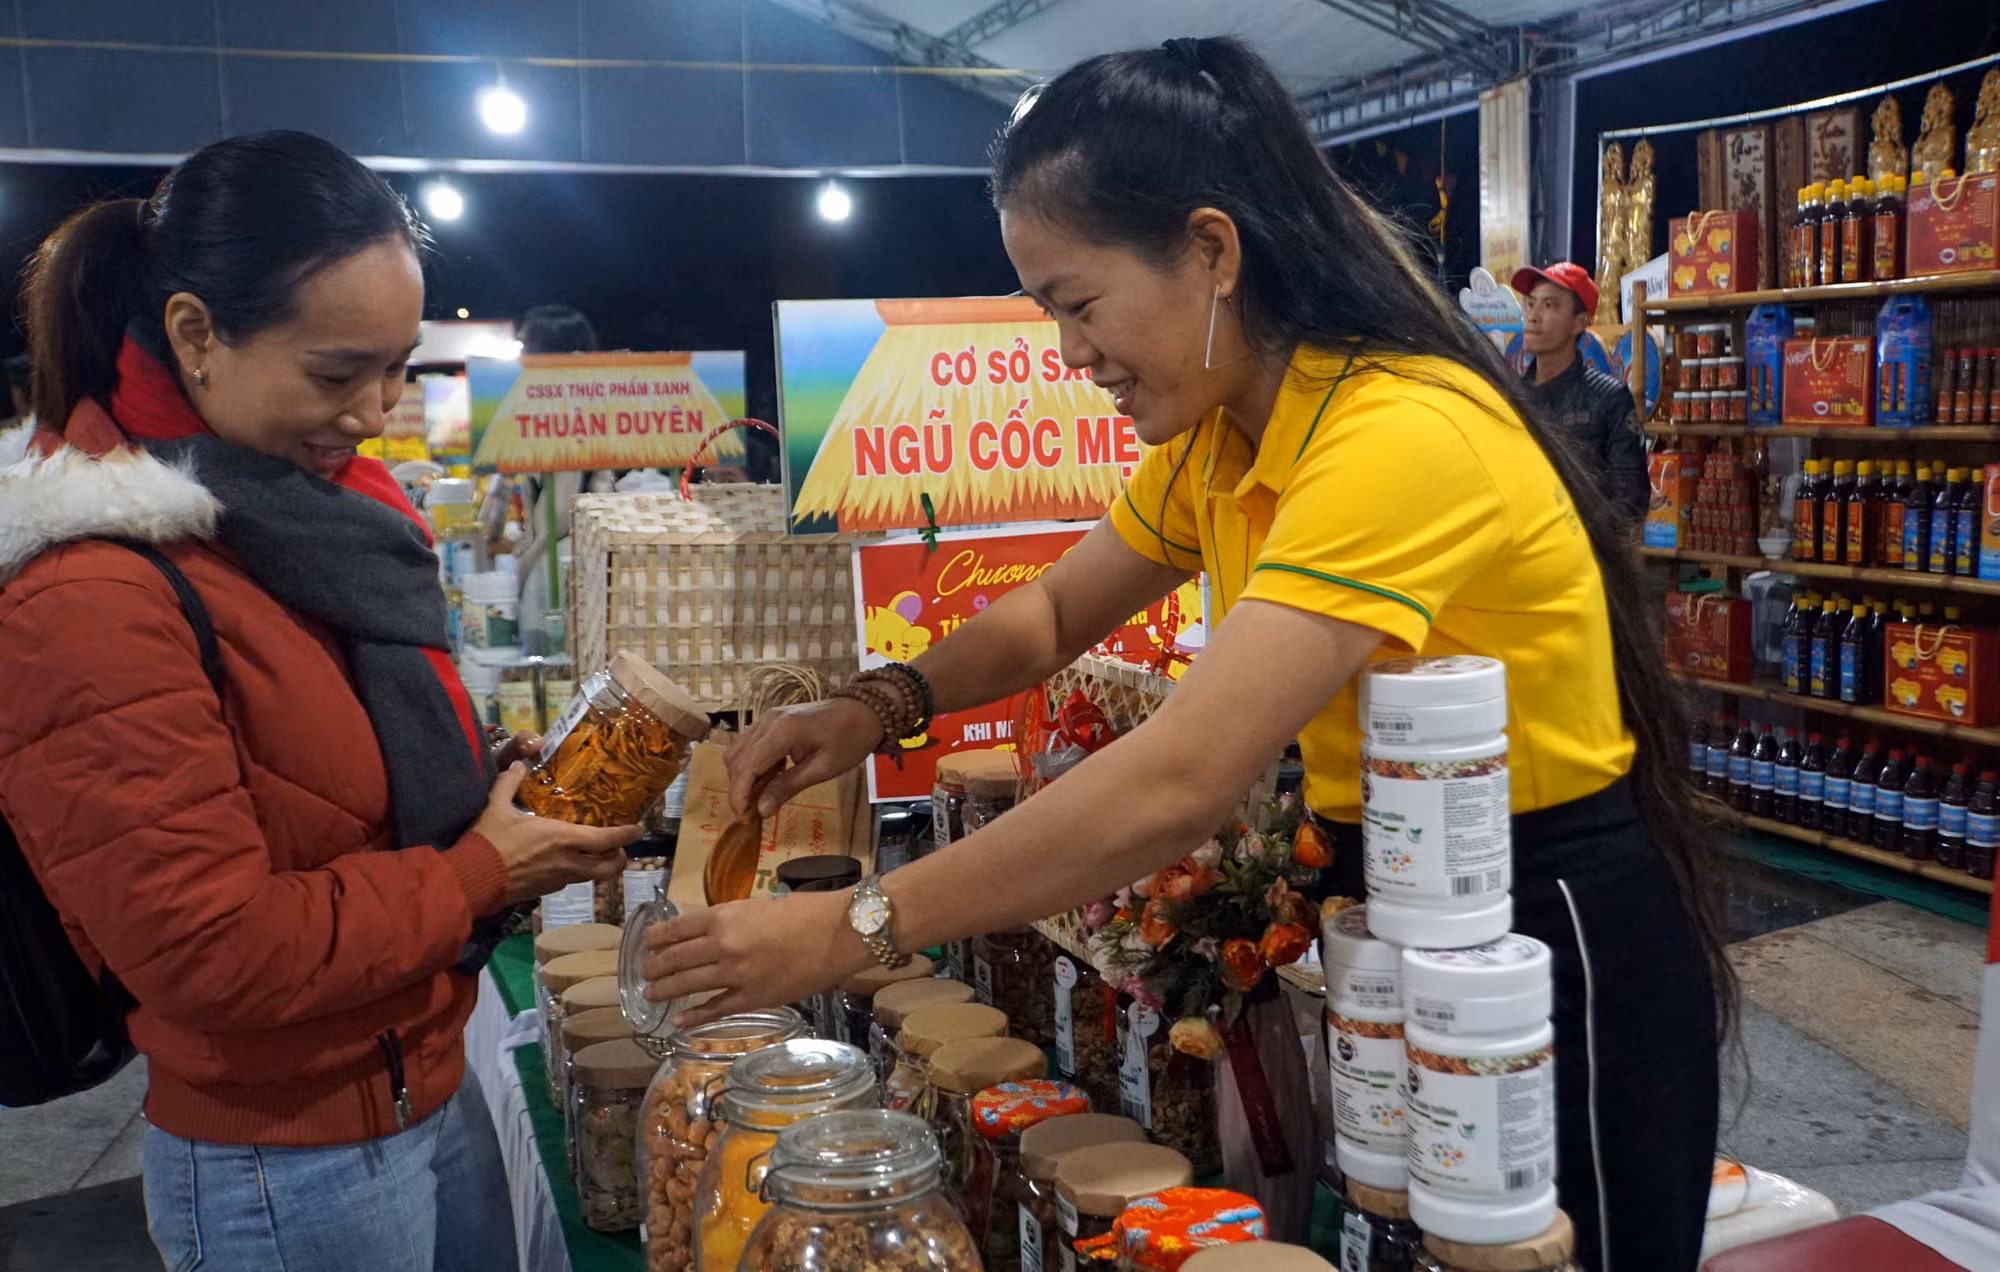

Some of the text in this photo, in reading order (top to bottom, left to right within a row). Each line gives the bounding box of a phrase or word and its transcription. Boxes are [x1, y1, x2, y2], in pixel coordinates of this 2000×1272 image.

[931, 345, 977, 386] CƠ
[988, 337, 1031, 384] SỞ
[526, 384, 563, 399] CSSX
[652, 381, 689, 396] XANH
[515, 404, 704, 443] THUẬN DUYÊN
[854, 399, 1140, 477] NGŨ CỐC MẸ
[963, 721, 991, 742] KHI
